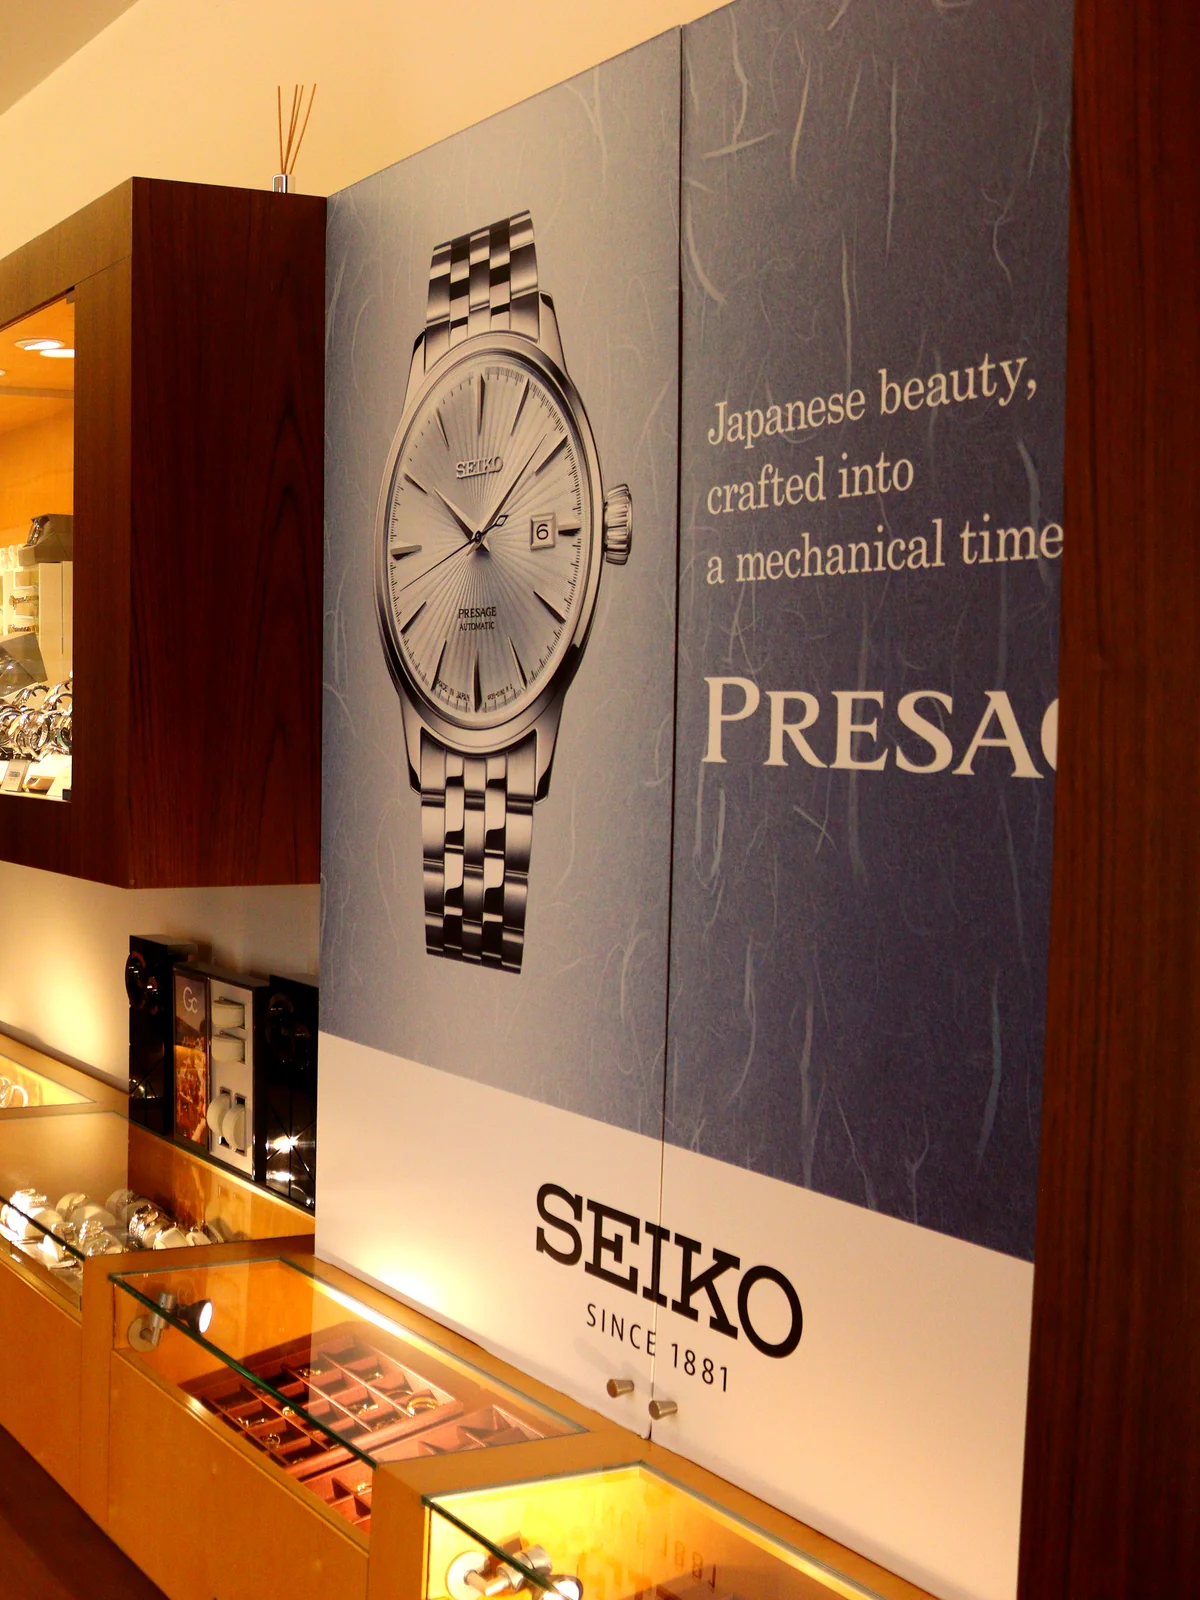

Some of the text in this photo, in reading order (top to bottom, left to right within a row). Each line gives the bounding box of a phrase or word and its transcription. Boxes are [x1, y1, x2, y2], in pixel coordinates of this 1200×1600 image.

[707, 352, 1038, 449] Japanese beauty,
[455, 456, 504, 479] SEIKO
[706, 451, 914, 515] crafted into
[536, 523, 549, 540] 6
[706, 513, 1064, 585] a mechanical time
[458, 606, 497, 619] PRESAGE
[459, 621, 495, 632] AUTOMATIC
[535, 1182, 804, 1359] SEIKO
[586, 1303, 728, 1393] SINCE 1881
